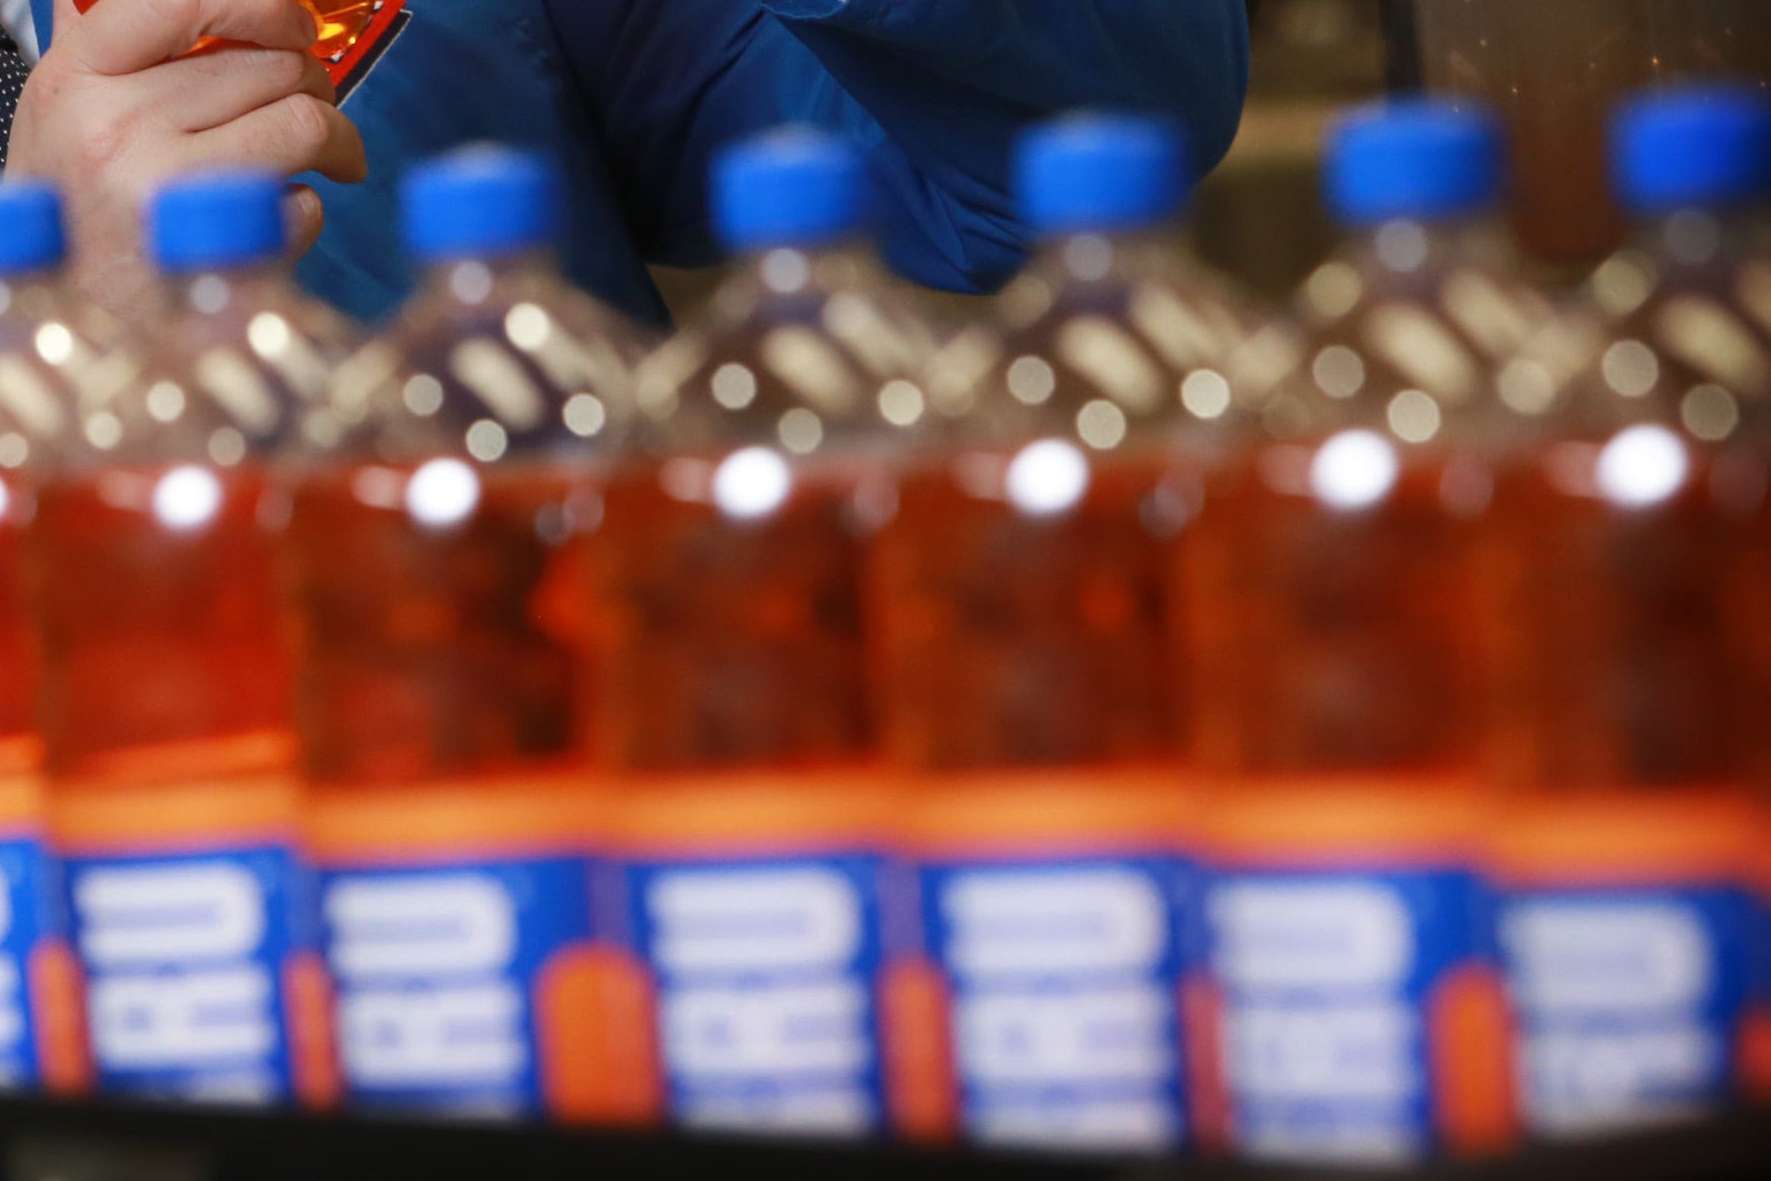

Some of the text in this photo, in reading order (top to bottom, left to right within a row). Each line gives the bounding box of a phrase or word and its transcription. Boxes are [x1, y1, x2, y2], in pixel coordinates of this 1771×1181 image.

[76, 862, 274, 1103] RU
[328, 874, 522, 1118] RU
[648, 868, 873, 1137] RU
[943, 867, 1175, 1147] RU
[1211, 876, 1418, 1159] RU
